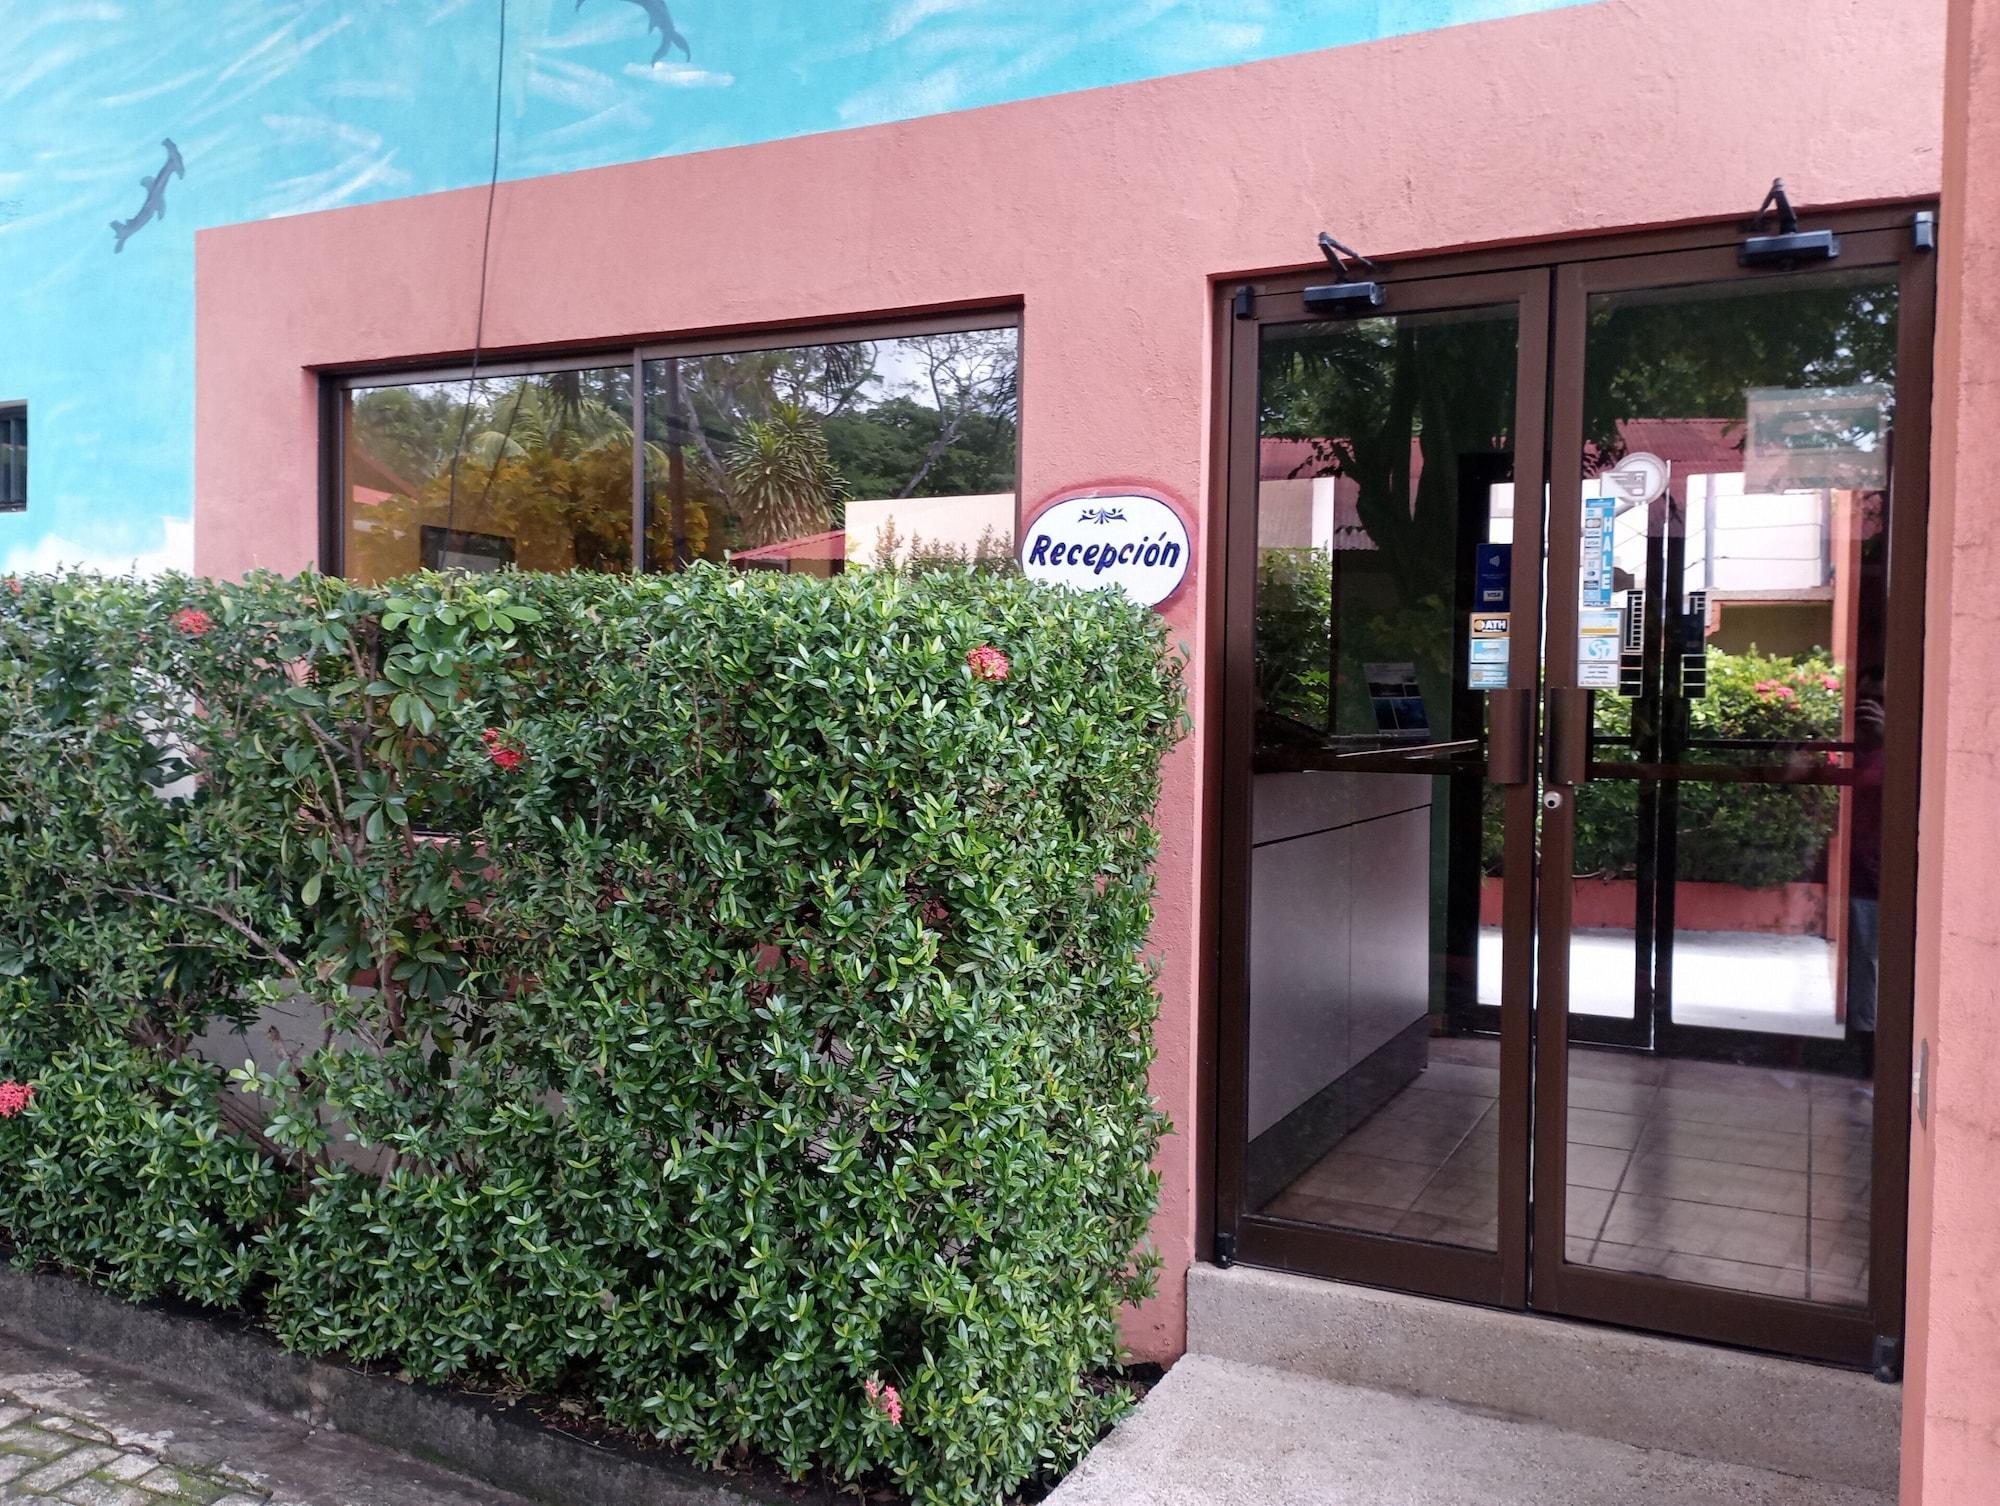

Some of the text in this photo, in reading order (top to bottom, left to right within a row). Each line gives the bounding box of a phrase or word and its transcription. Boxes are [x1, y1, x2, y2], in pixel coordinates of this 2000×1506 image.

[1028, 531, 1181, 575] Recepción
[1601, 516, 1613, 590] HALE
[1485, 620, 1506, 630] ATH
